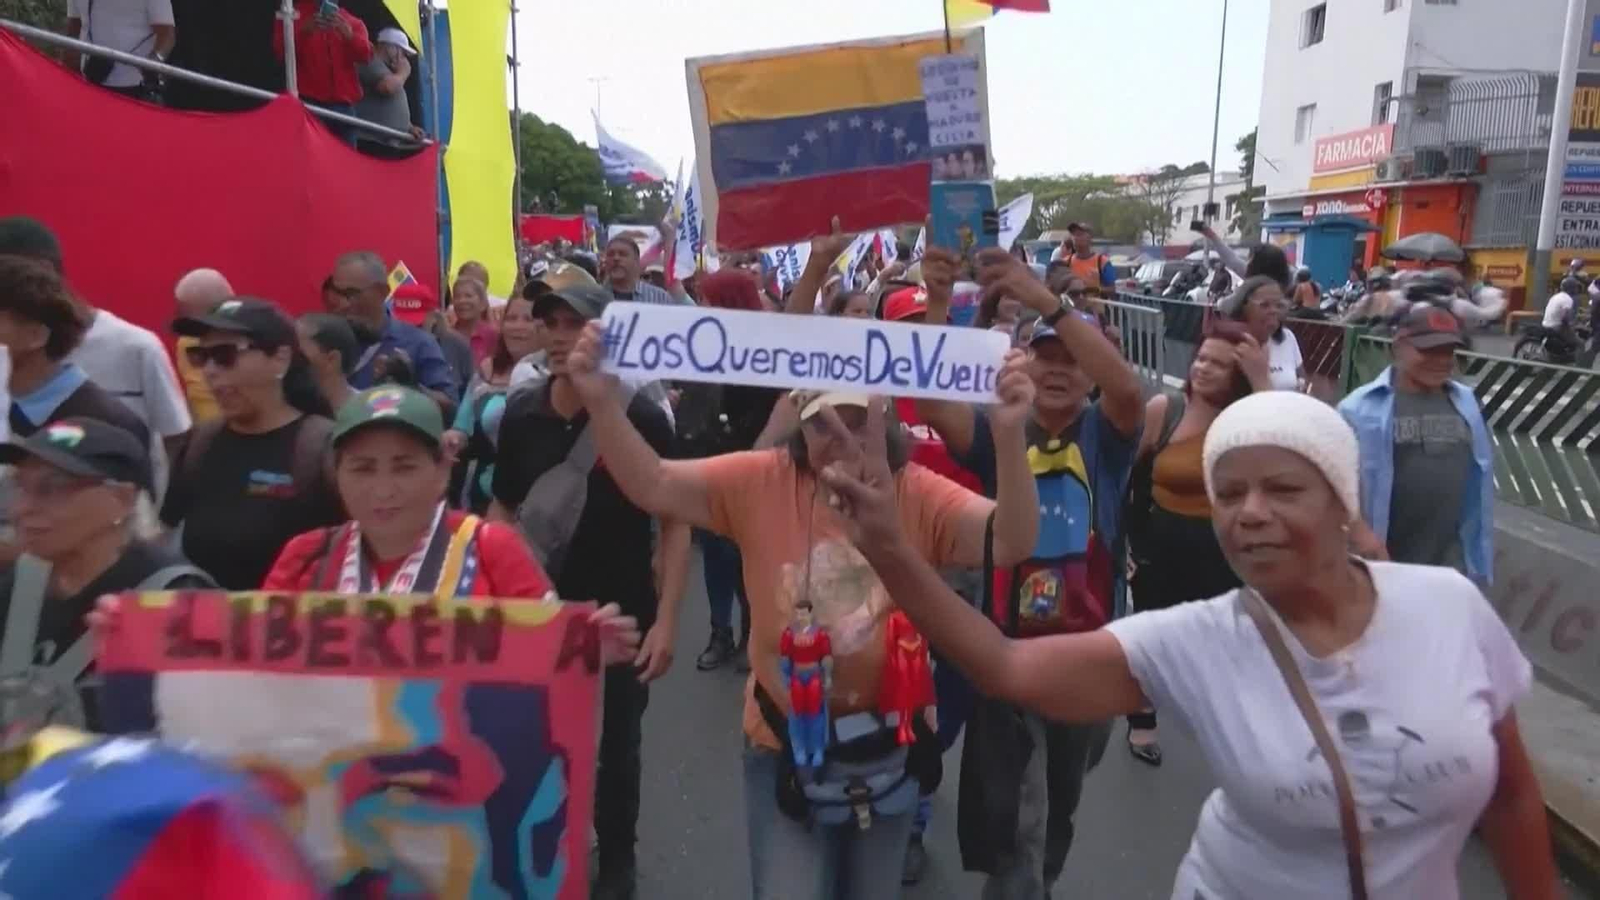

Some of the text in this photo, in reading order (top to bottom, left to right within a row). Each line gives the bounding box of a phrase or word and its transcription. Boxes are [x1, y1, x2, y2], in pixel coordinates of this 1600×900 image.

[1316, 132, 1387, 167] FARMACIA
[163, 596, 601, 673] LIBEREN A
